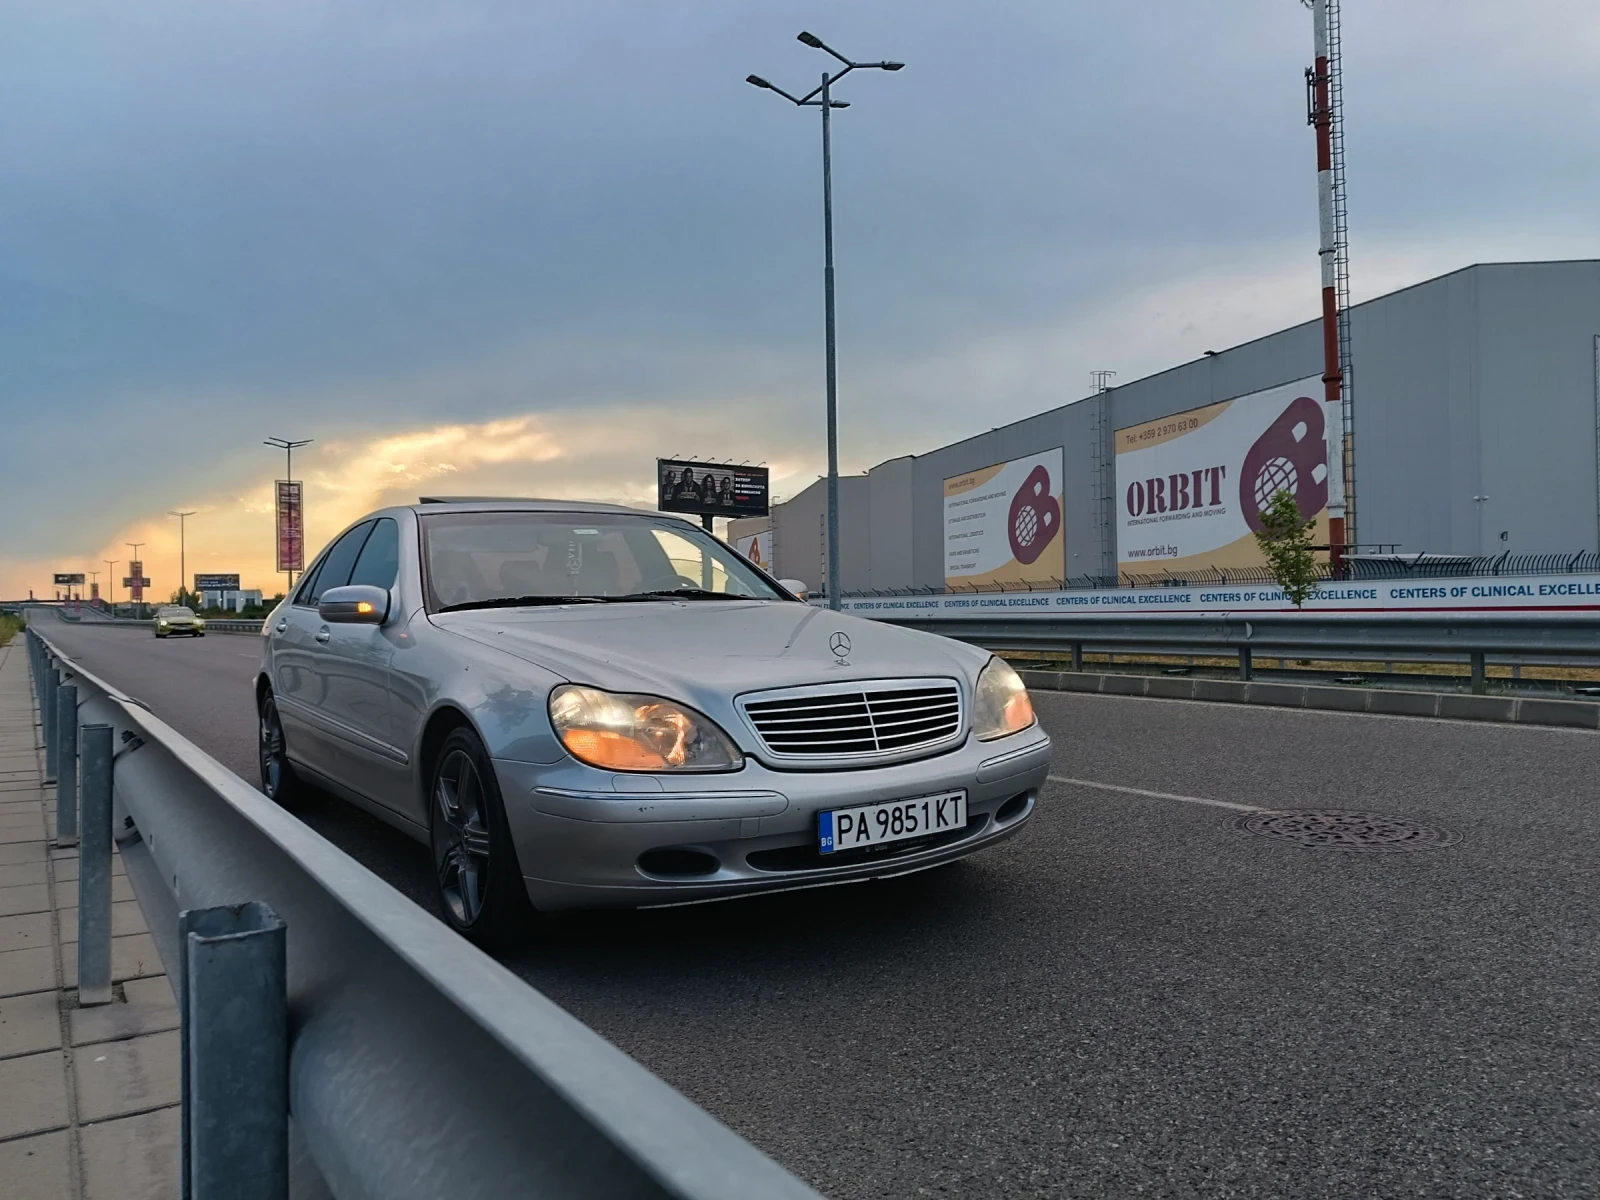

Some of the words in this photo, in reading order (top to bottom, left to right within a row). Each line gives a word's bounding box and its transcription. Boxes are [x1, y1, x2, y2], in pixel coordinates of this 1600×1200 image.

[1126, 434, 1138, 444] Tel:
[1139, 428, 1156, 440] +359
[1157, 427, 1162, 436] 2
[1163, 424, 1176, 435] 970
[1178, 422, 1187, 432] 63
[1189, 418, 1198, 428] 00
[1127, 466, 1226, 517] ORBIT
[1128, 516, 1158, 526] INTERNATIONAL
[1160, 512, 1190, 523] FORWARDING
[1204, 508, 1226, 517] MOVING
[1128, 545, 1178, 558] www.orbit.bg
[1200, 593, 1241, 602] CENTERS
[1244, 592, 1256, 602] OF
[1308, 589, 1377, 600] EXCELLENCE
[1390, 588, 1446, 598] CENTERS
[1450, 587, 1468, 597] OF
[1472, 585, 1534, 597] CLINICAL
[906, 600, 939, 608] EXCELLENCE
[1009, 598, 1050, 606] EXCELLENCE
[1056, 597, 1088, 606] CENTERS
[1090, 596, 1100, 604] OF
[1102, 595, 1136, 604] CLINICAL
[1139, 594, 1191, 603] EXCELLENCE
[838, 812, 870, 844] PA
[876, 802, 929, 838] 9851
[936, 796, 962, 828] KT
[821, 836, 832, 847] BG
